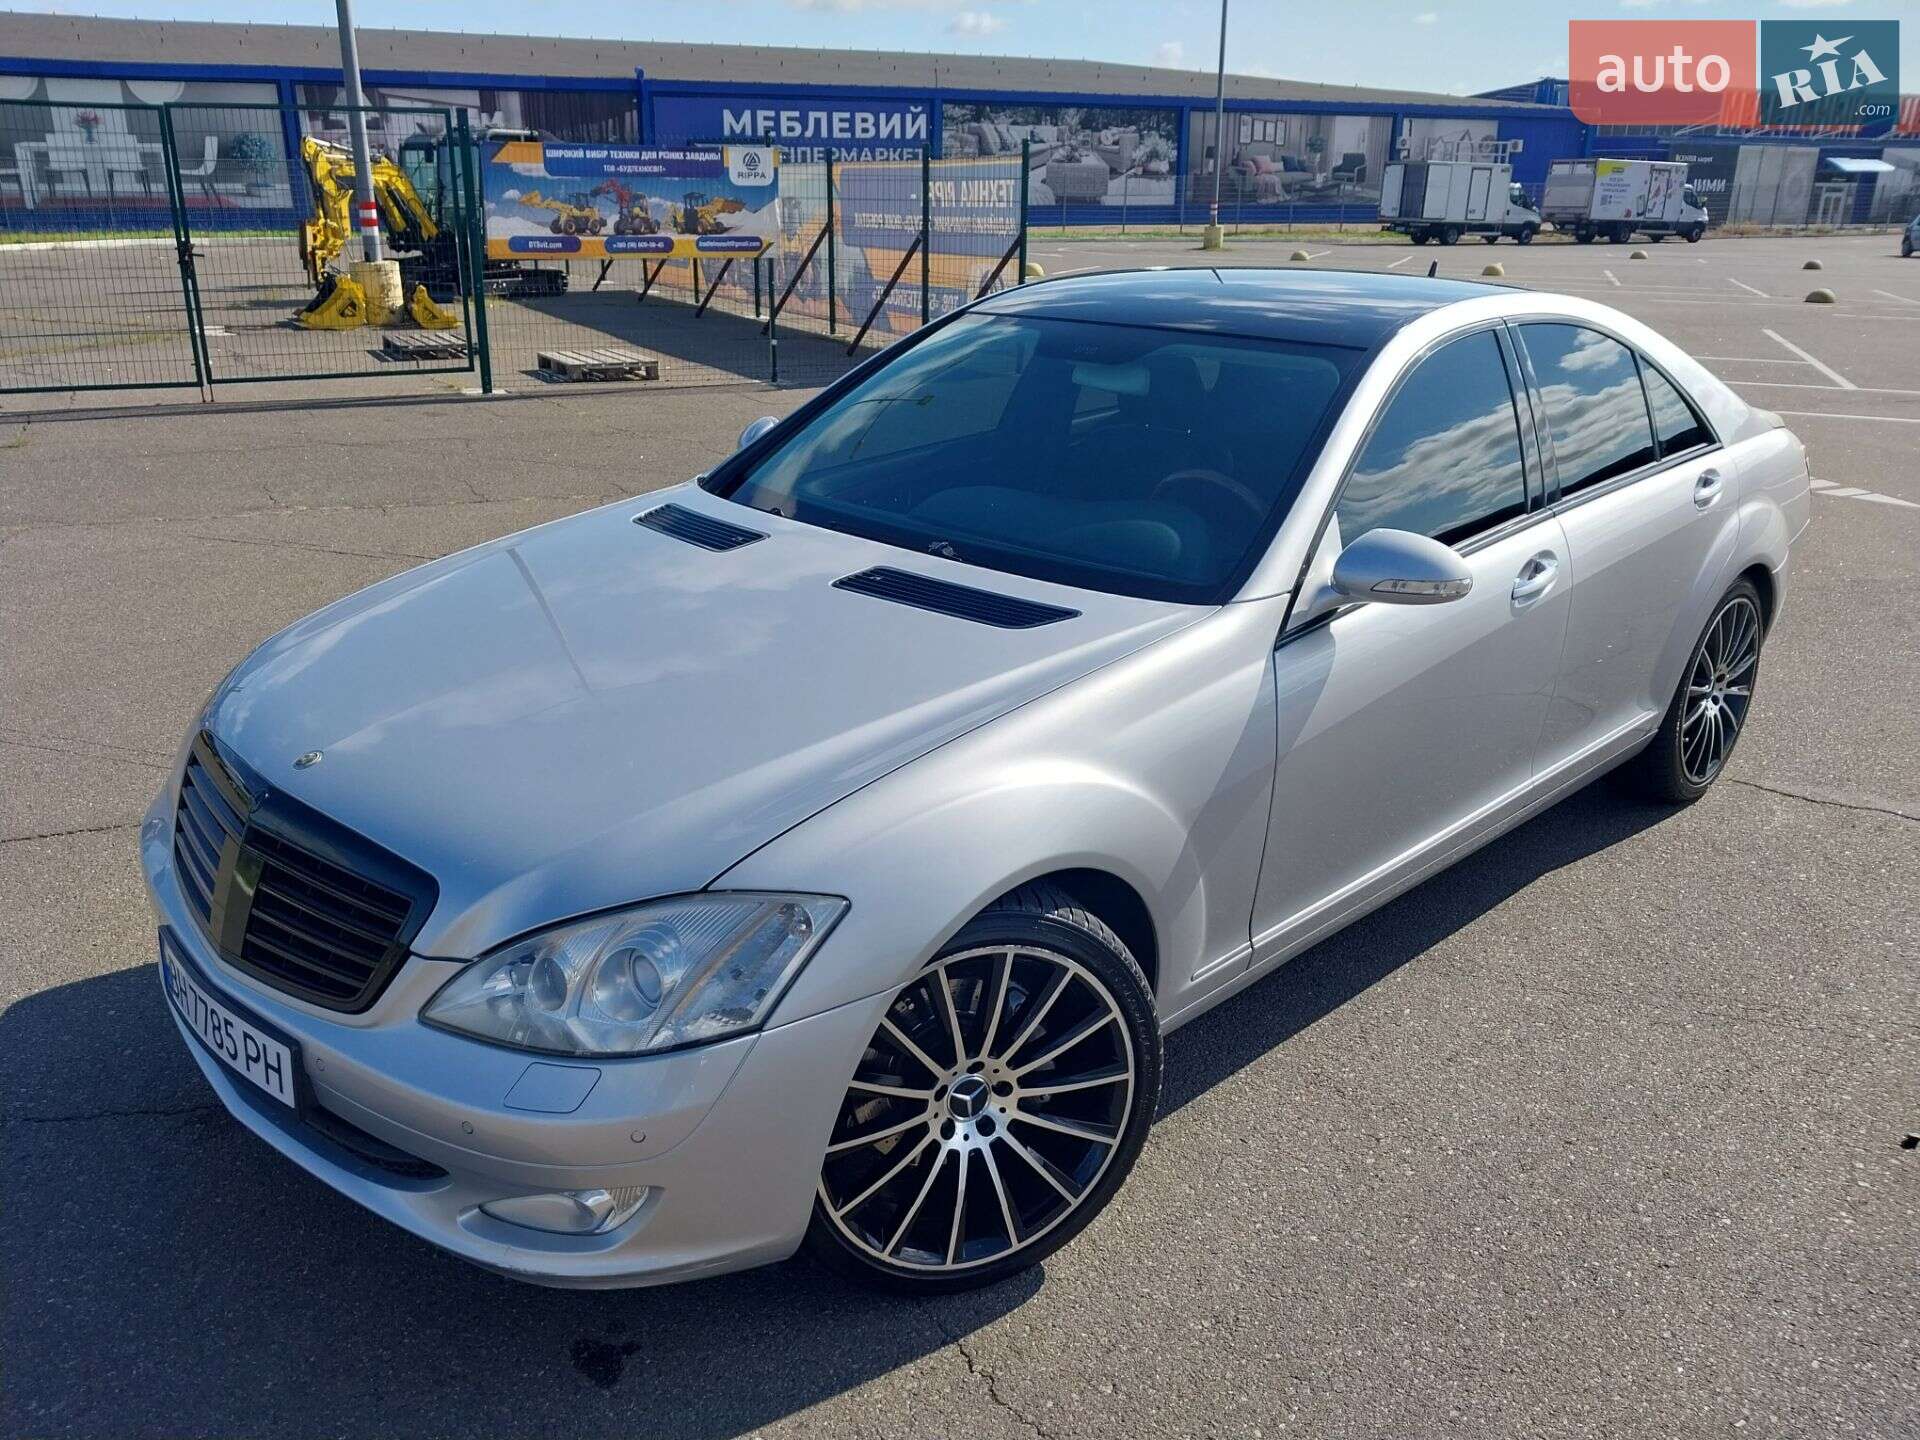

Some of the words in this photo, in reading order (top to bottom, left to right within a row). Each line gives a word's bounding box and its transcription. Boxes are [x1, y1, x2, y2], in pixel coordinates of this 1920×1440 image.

[722, 106, 927, 140] МЕБЛЕВИЙ
[545, 148, 584, 158] ШИРОКИЙ
[585, 150, 608, 159] ВИБІР
[609, 150, 640, 159] ТЕХНІКИ
[641, 151, 657, 160] ДЛЯ
[658, 151, 684, 160] РІЗНИХ
[190, 985, 239, 1061] 7785
[242, 1030, 284, 1095] PH
